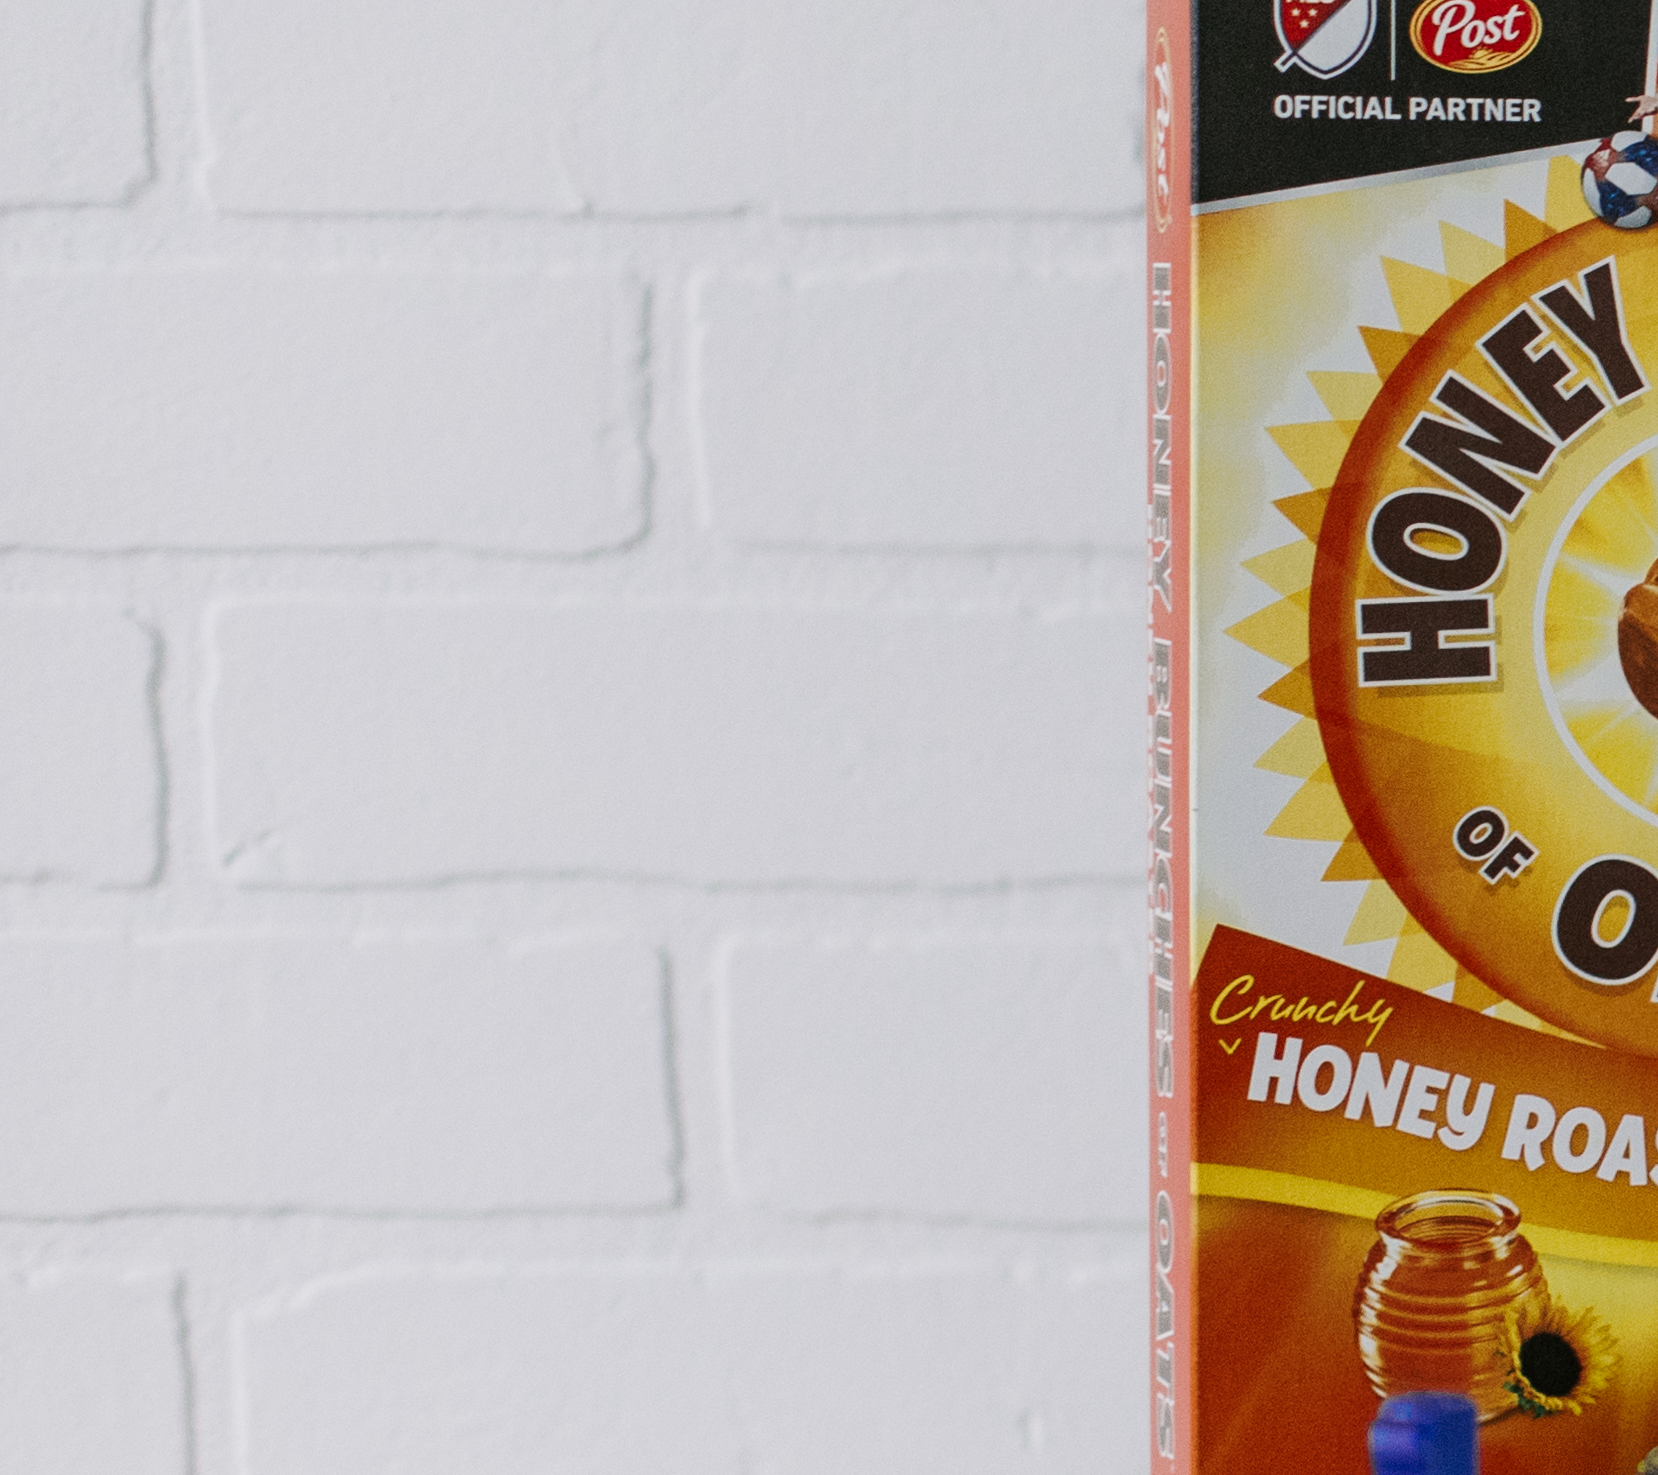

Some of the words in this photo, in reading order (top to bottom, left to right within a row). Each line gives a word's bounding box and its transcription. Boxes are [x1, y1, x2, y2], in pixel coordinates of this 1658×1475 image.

[1273, 94, 1402, 120] OFFICIAL
[1409, 97, 1541, 122] PARTNER
[1152, 262, 1172, 614] HONEY
[1356, 253, 1647, 689] HONEY
[1153, 636, 1174, 1098] BUNCHES
[1452, 806, 1541, 885] OF
[1209, 973, 1395, 1045] Crunchy
[1246, 1031, 1497, 1153] HONEY
[1154, 1190, 1176, 1459] OATS
